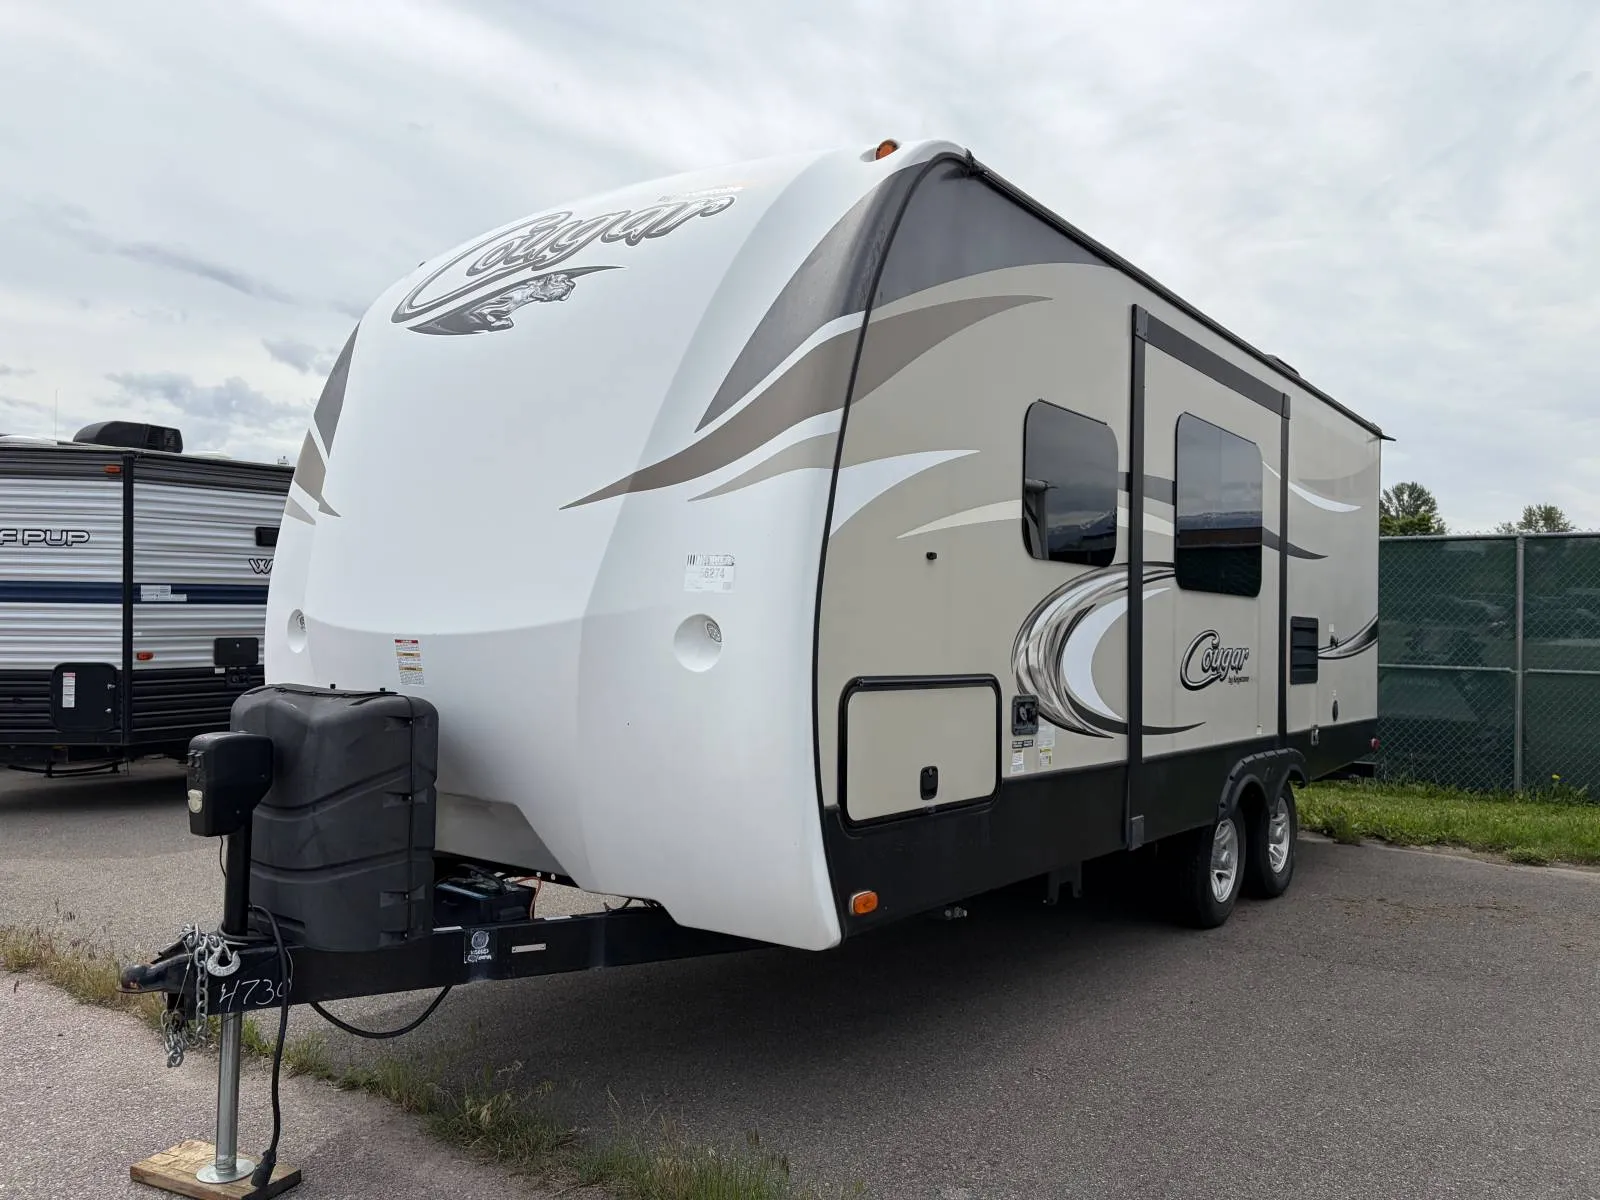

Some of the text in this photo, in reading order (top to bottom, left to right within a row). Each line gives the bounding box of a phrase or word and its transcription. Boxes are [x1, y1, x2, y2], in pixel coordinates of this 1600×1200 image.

[391, 195, 735, 324] Cougar
[22, 529, 91, 546] PUP
[1180, 629, 1250, 691] Cougar
